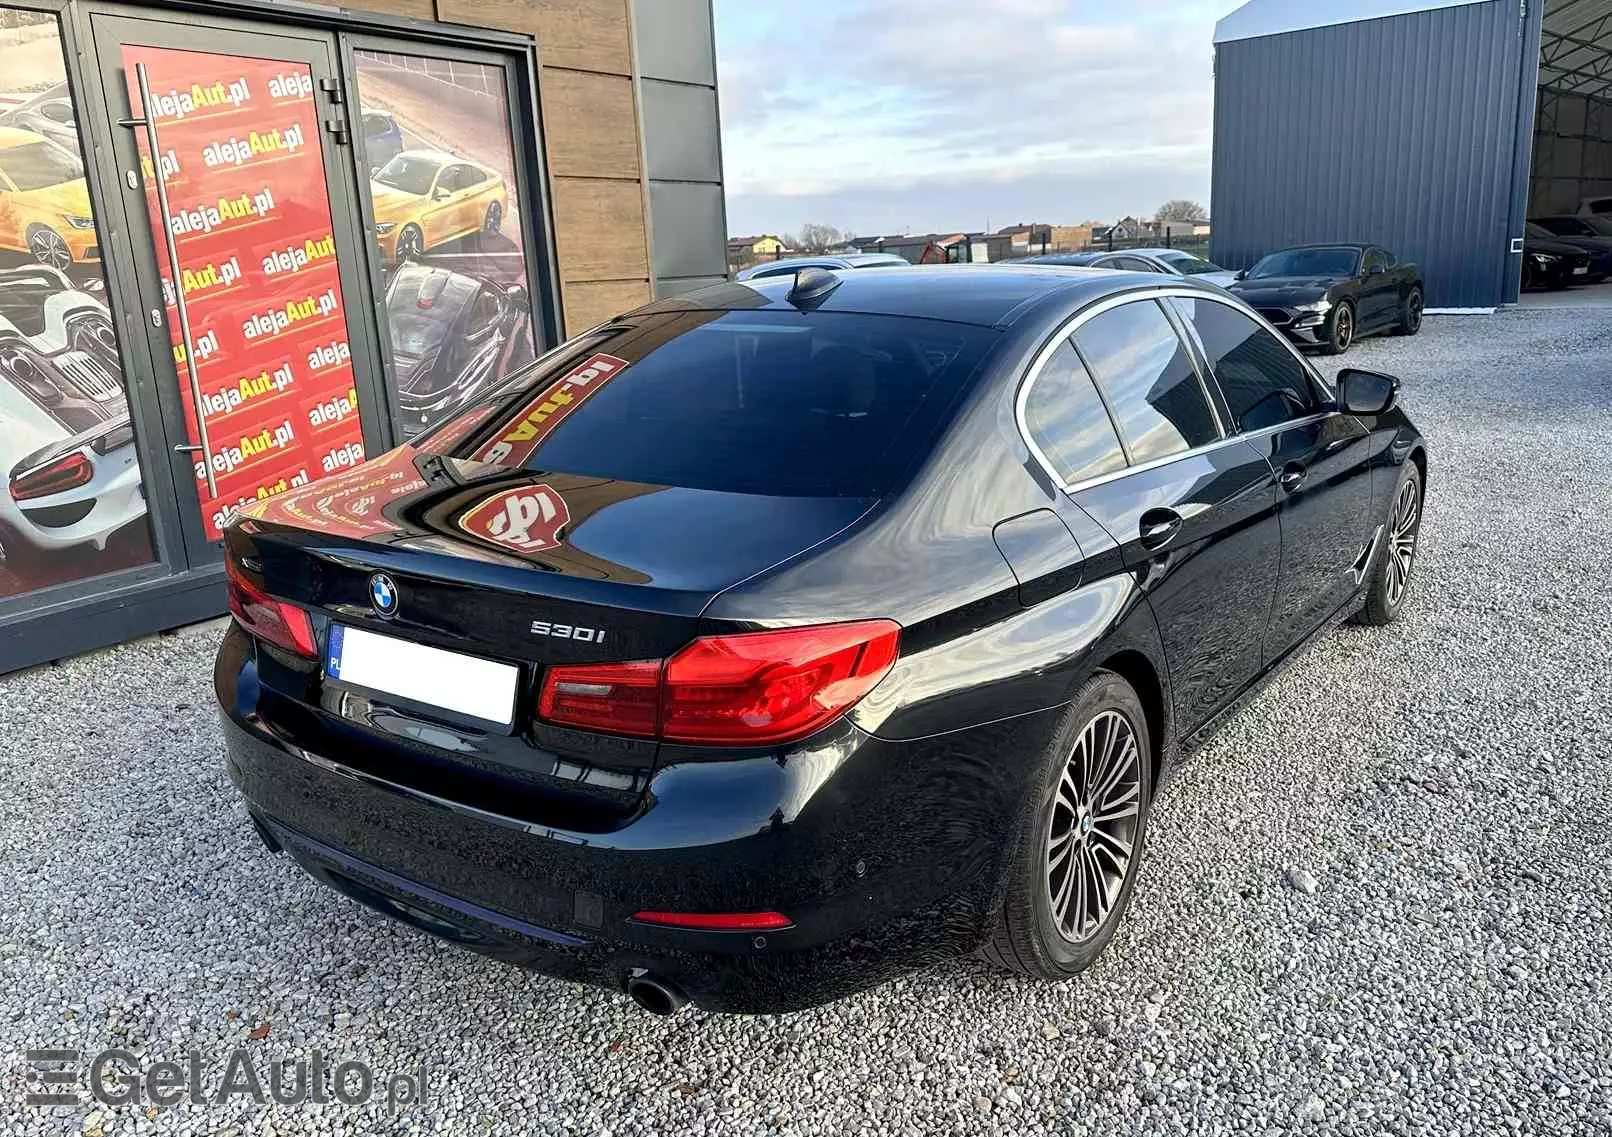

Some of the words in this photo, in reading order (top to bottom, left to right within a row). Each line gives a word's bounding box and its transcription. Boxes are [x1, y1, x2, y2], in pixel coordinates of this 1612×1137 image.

[150, 77, 251, 119] lejaAut.pl
[202, 123, 304, 167] alejaAut.pl
[170, 187, 276, 236] alejaAut.pl
[262, 234, 336, 275] alejaAut
[242, 288, 338, 339] alejaAut.pl
[307, 340, 351, 370] aleja
[194, 420, 295, 480] aejaAut.pl
[321, 442, 365, 473] aleja
